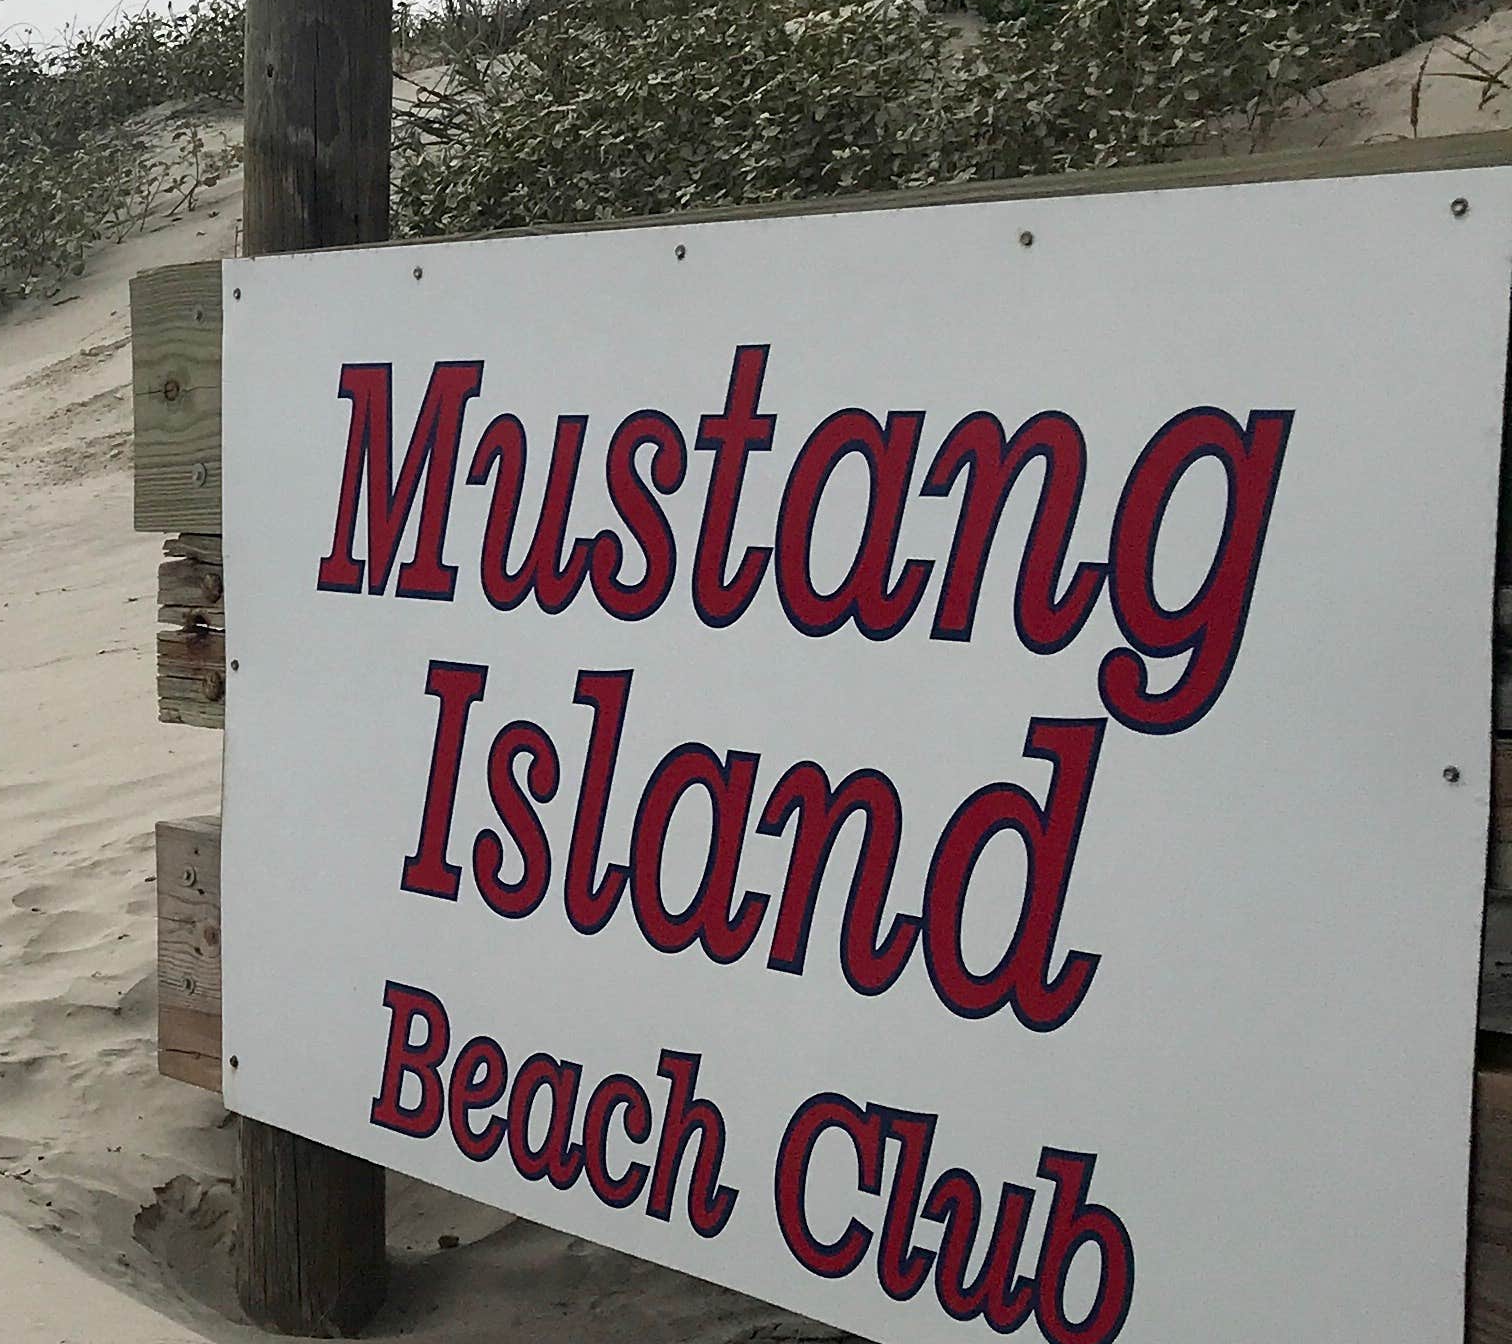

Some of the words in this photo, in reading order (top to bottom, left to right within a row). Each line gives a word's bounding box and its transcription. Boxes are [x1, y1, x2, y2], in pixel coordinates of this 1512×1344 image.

[317, 344, 1296, 735] Mustang
[400, 660, 1108, 1033] Island
[370, 980, 739, 1237] Beach
